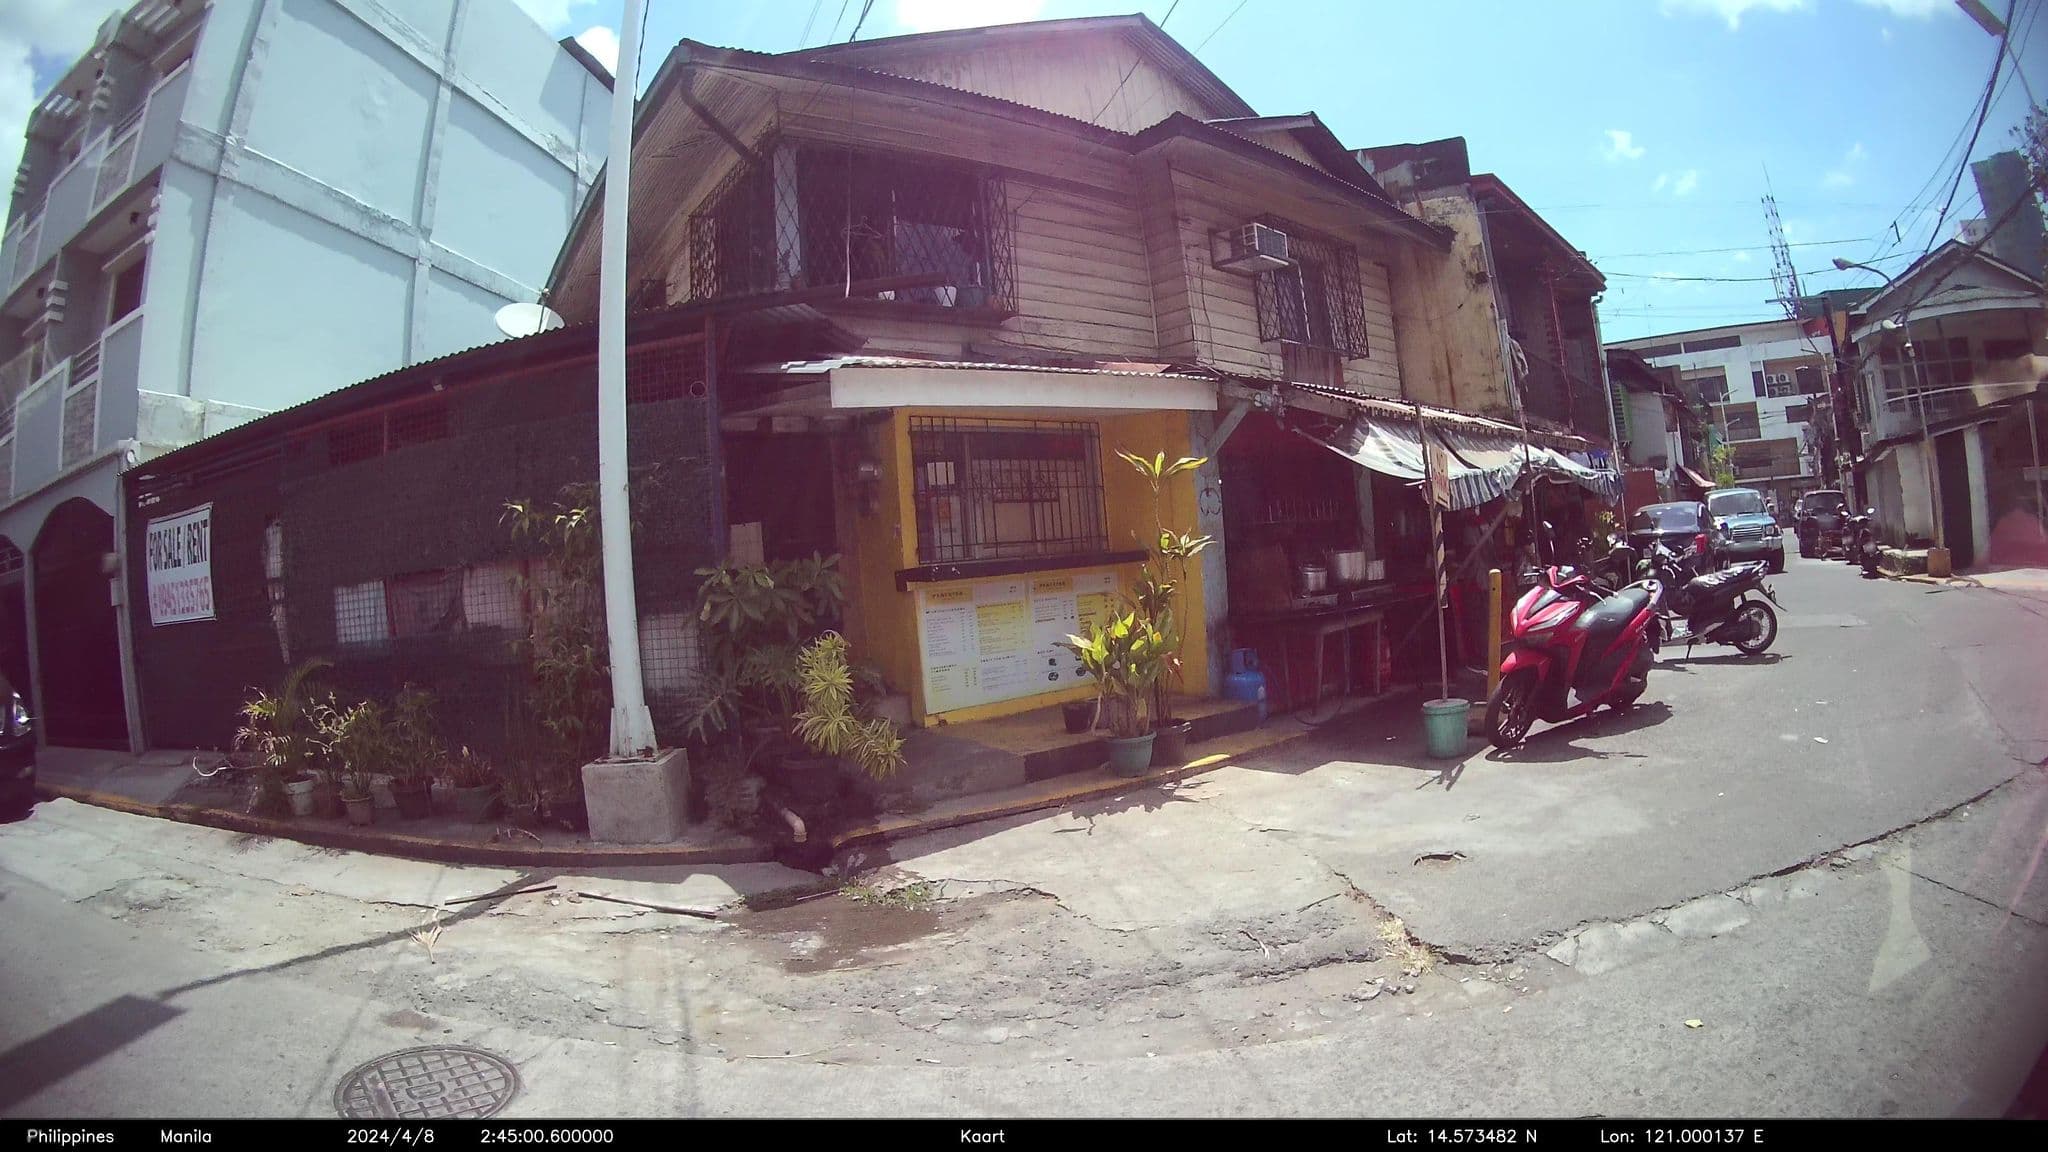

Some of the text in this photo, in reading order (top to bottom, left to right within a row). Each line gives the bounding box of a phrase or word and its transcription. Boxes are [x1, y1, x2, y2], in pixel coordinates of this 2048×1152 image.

[149, 531, 163, 571] FOR
[163, 526, 182, 570] SALE
[187, 519, 208, 565] RENT
